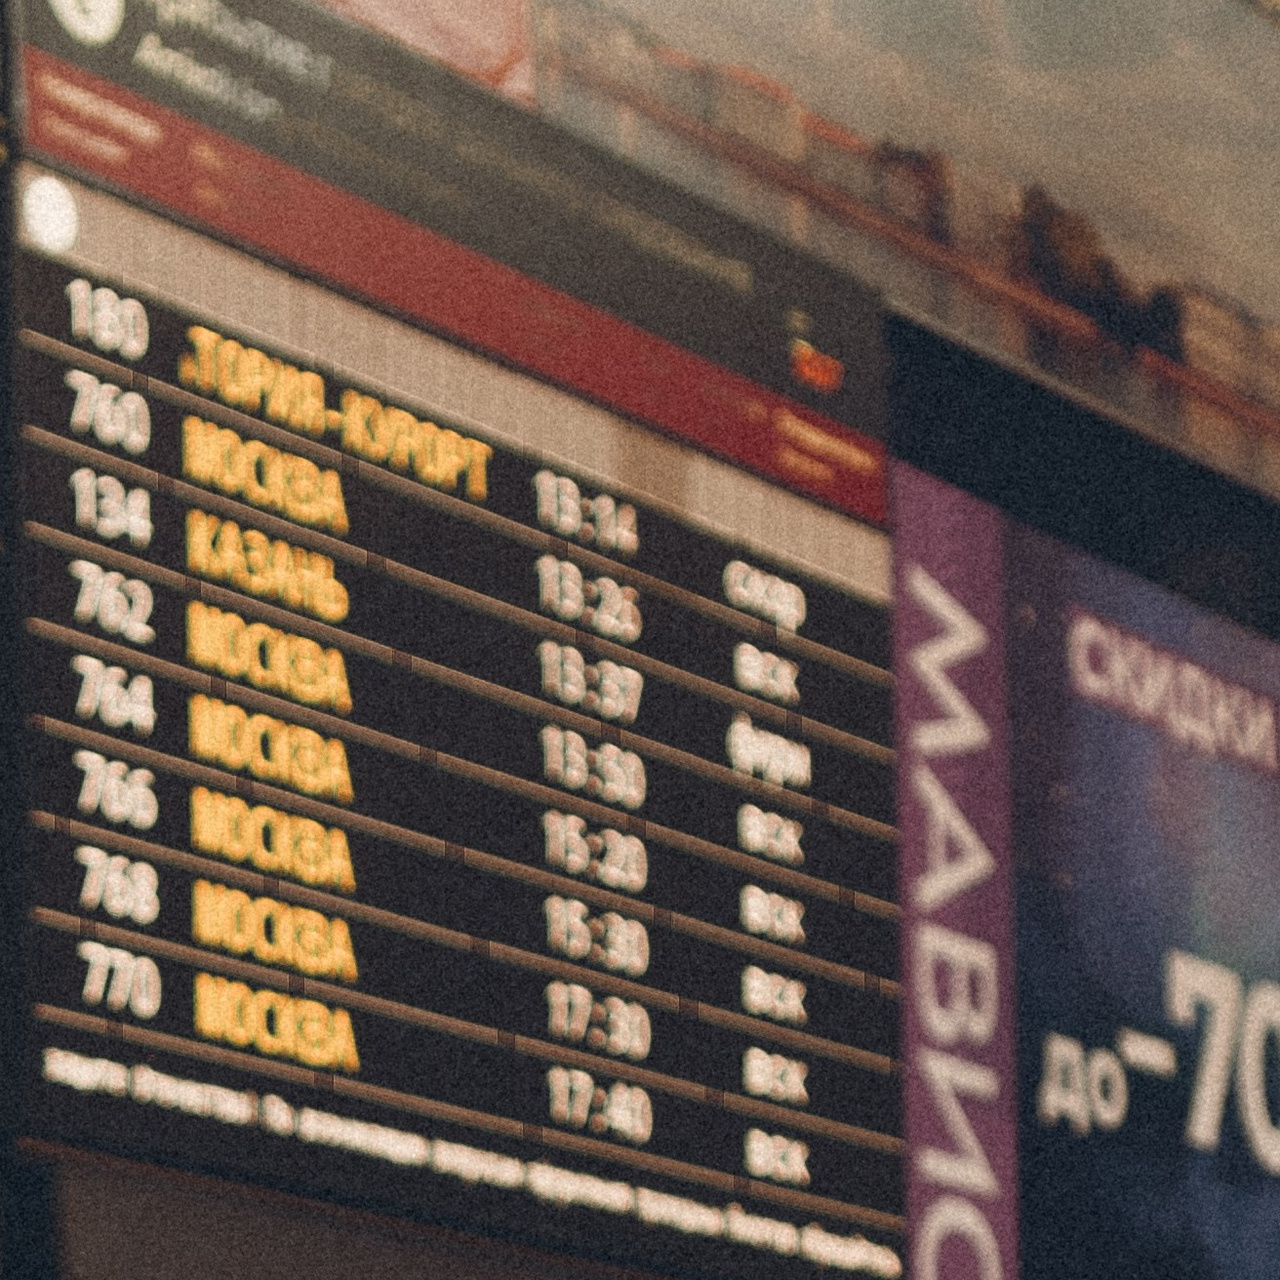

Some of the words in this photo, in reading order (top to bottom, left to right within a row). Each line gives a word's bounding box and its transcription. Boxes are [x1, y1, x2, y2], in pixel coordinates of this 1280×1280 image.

[65, 279, 149, 359] 180
[533, 470, 639, 555] 13:14
[65, 369, 151, 453] 760
[183, 415, 349, 535] МОСКВА
[535, 555, 643, 643] 13:25
[70, 467, 154, 547] 134
[187, 509, 350, 621] КАЗАНЬ
[69, 558, 156, 644] 762
[187, 601, 353, 713] МОСКВА
[1067, 614, 1277, 770] СКИДКИ
[72, 655, 157, 734] 764
[188, 693, 353, 803] МОСКВА
[74, 750, 158, 828] 766
[191, 787, 356, 893] МОСКВА
[75, 845, 160, 924] 768
[194, 879, 359, 981] МОСКВА
[78, 940, 161, 1018] 770
[195, 973, 361, 1072] МОСКВА
